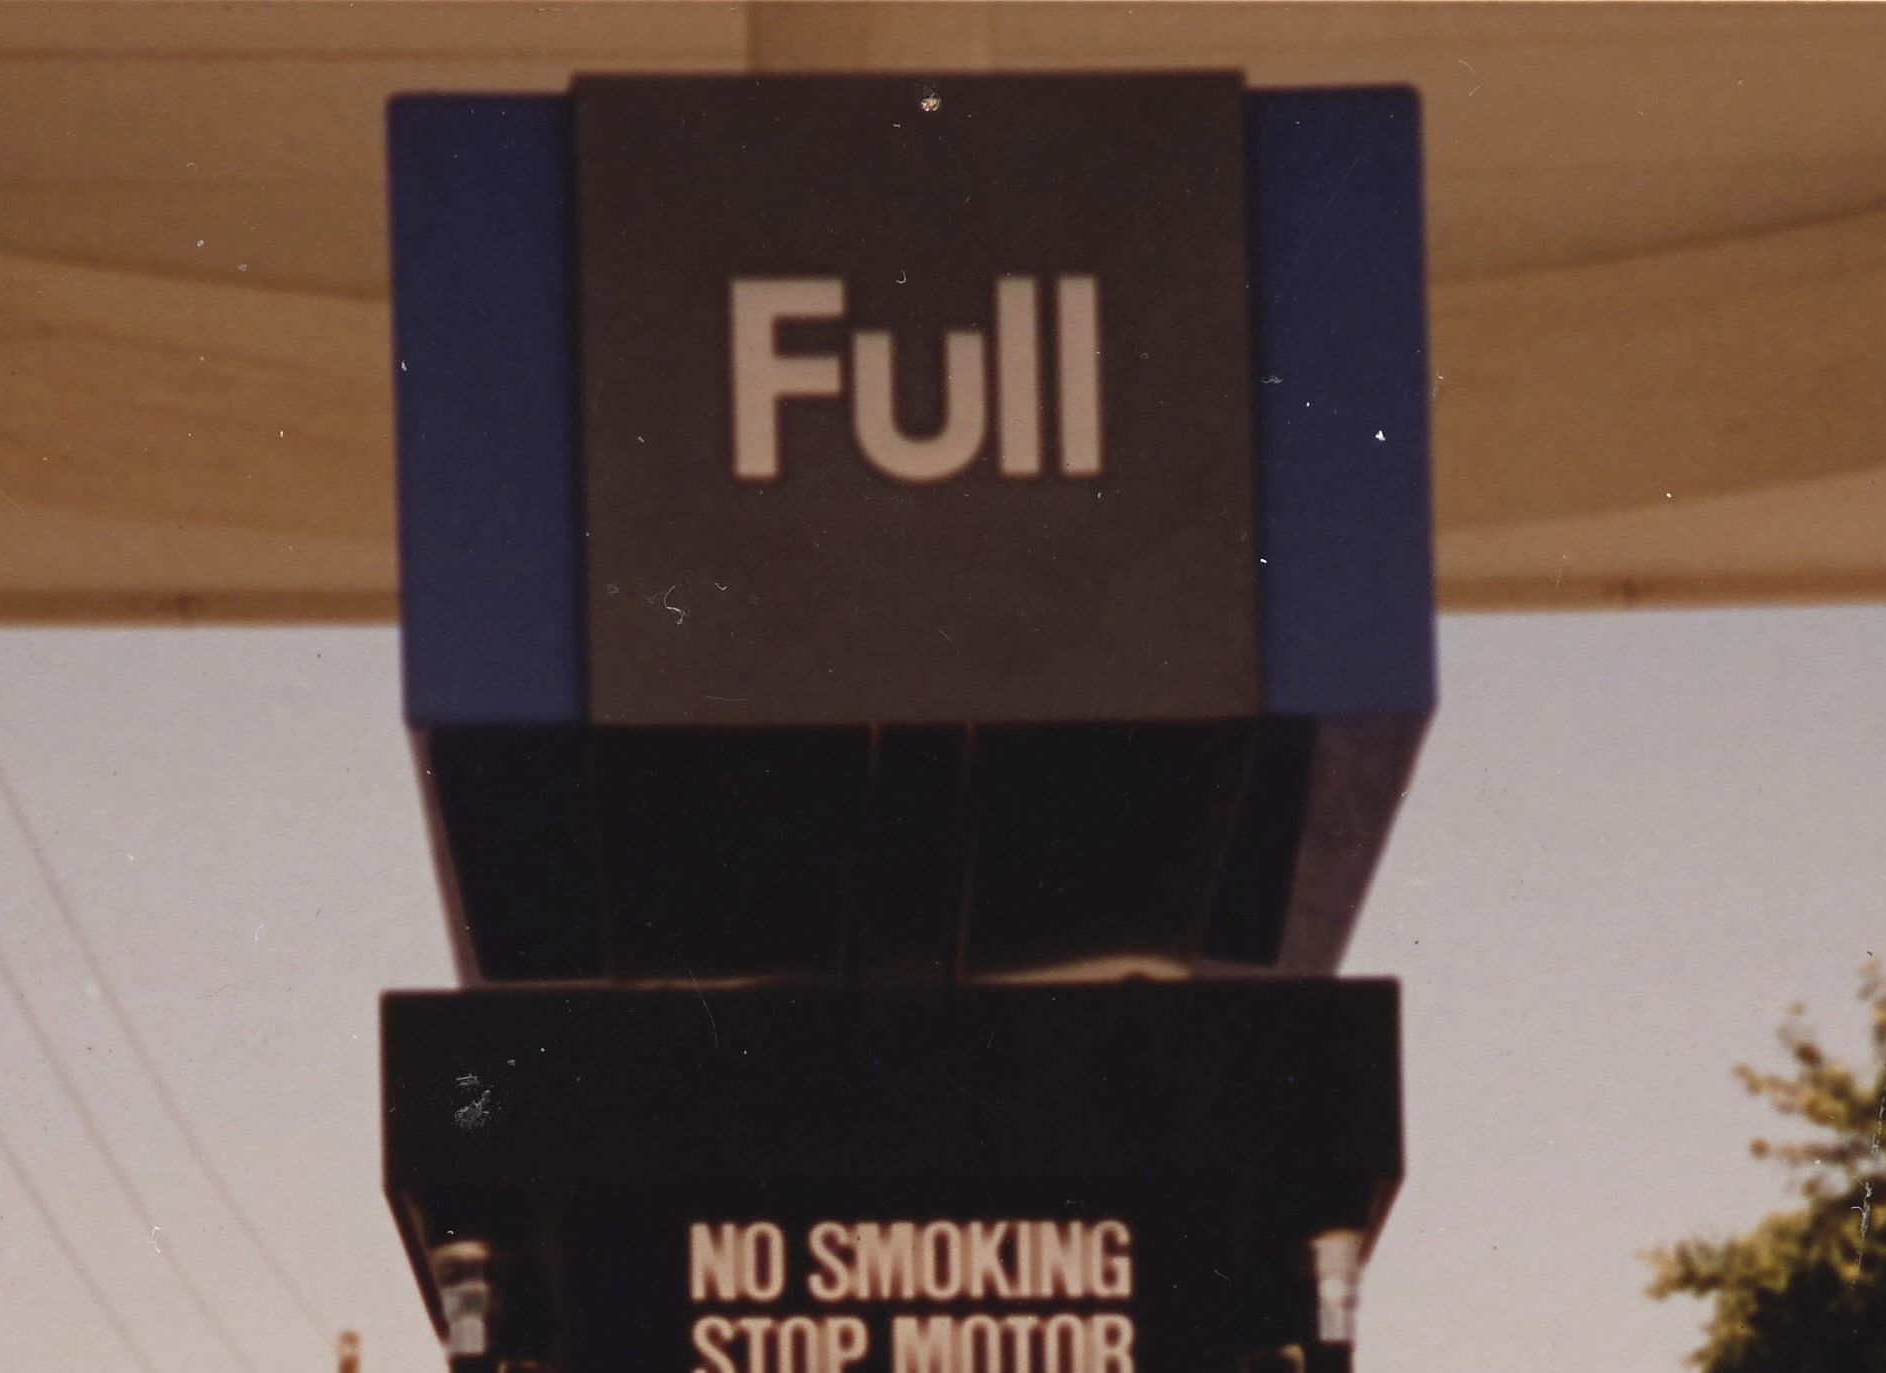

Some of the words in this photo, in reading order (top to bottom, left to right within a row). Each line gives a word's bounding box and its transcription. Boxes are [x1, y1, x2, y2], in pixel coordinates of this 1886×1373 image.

[728, 274, 1102, 483] Full
[688, 1220, 786, 1302] NO
[806, 1219, 1135, 1302] SMOKING
